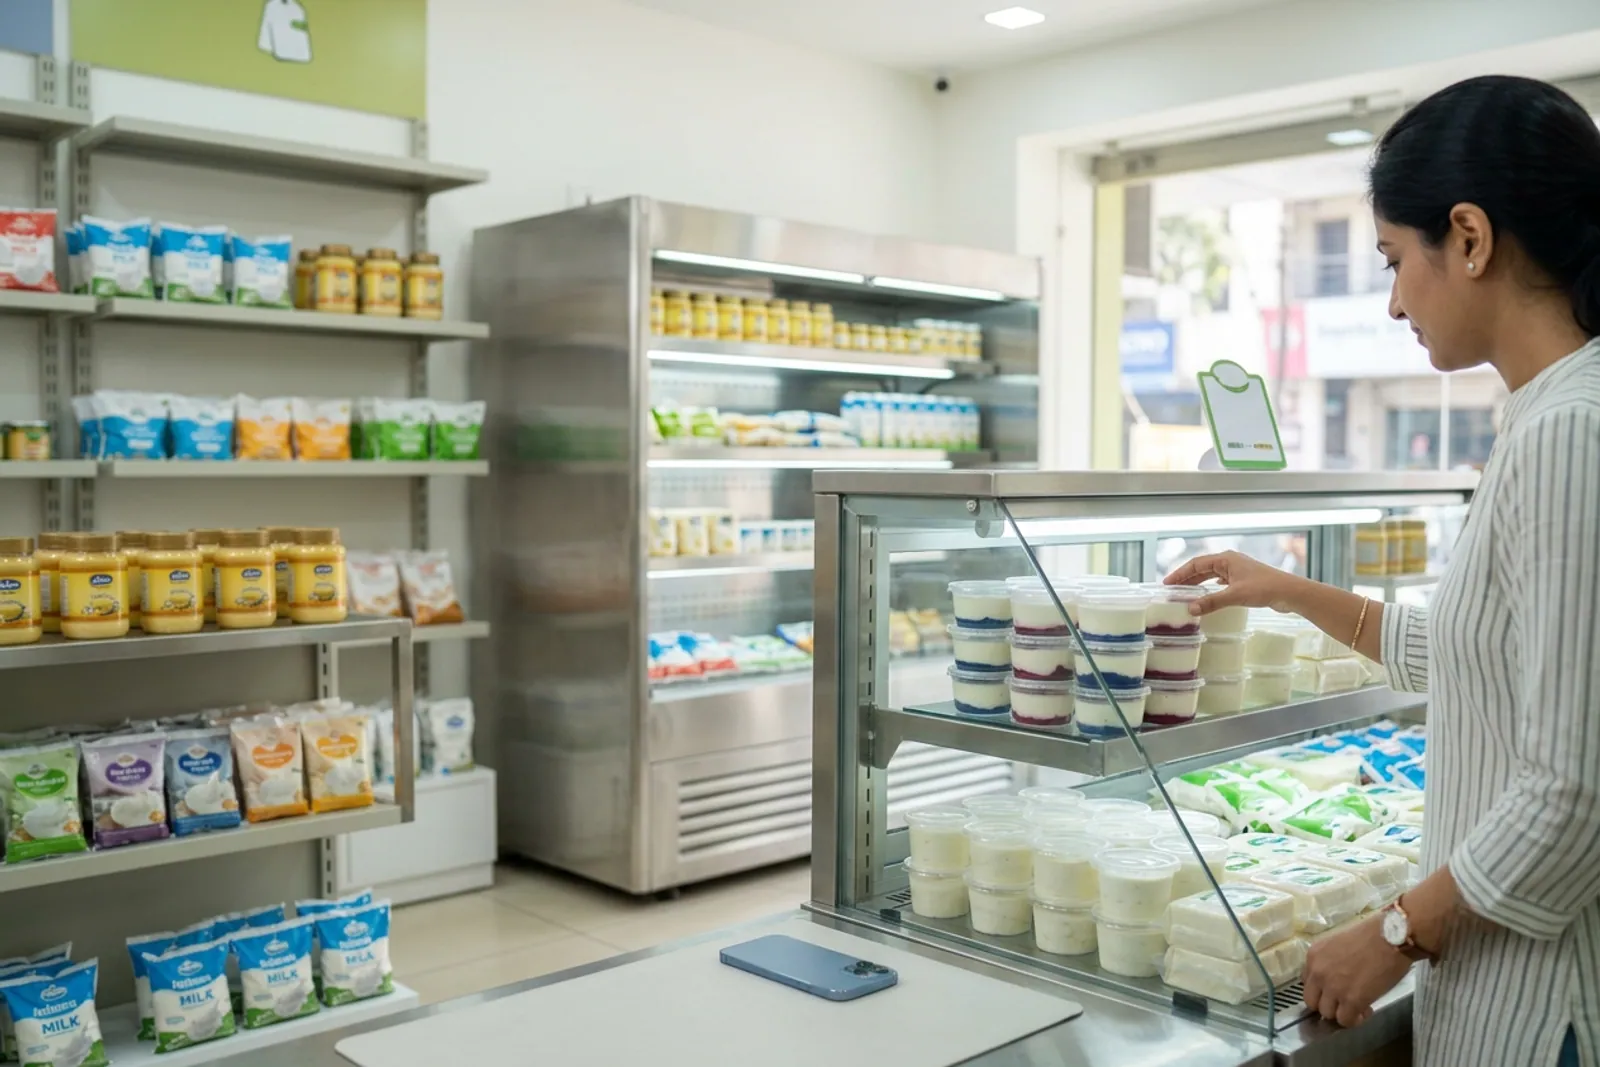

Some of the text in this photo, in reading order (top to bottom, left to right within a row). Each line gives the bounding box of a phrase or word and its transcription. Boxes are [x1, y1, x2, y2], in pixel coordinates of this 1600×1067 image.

[268, 969, 299, 983] MILK
[179, 990, 215, 1006] MILK
[42, 1015, 80, 1034] MILK
